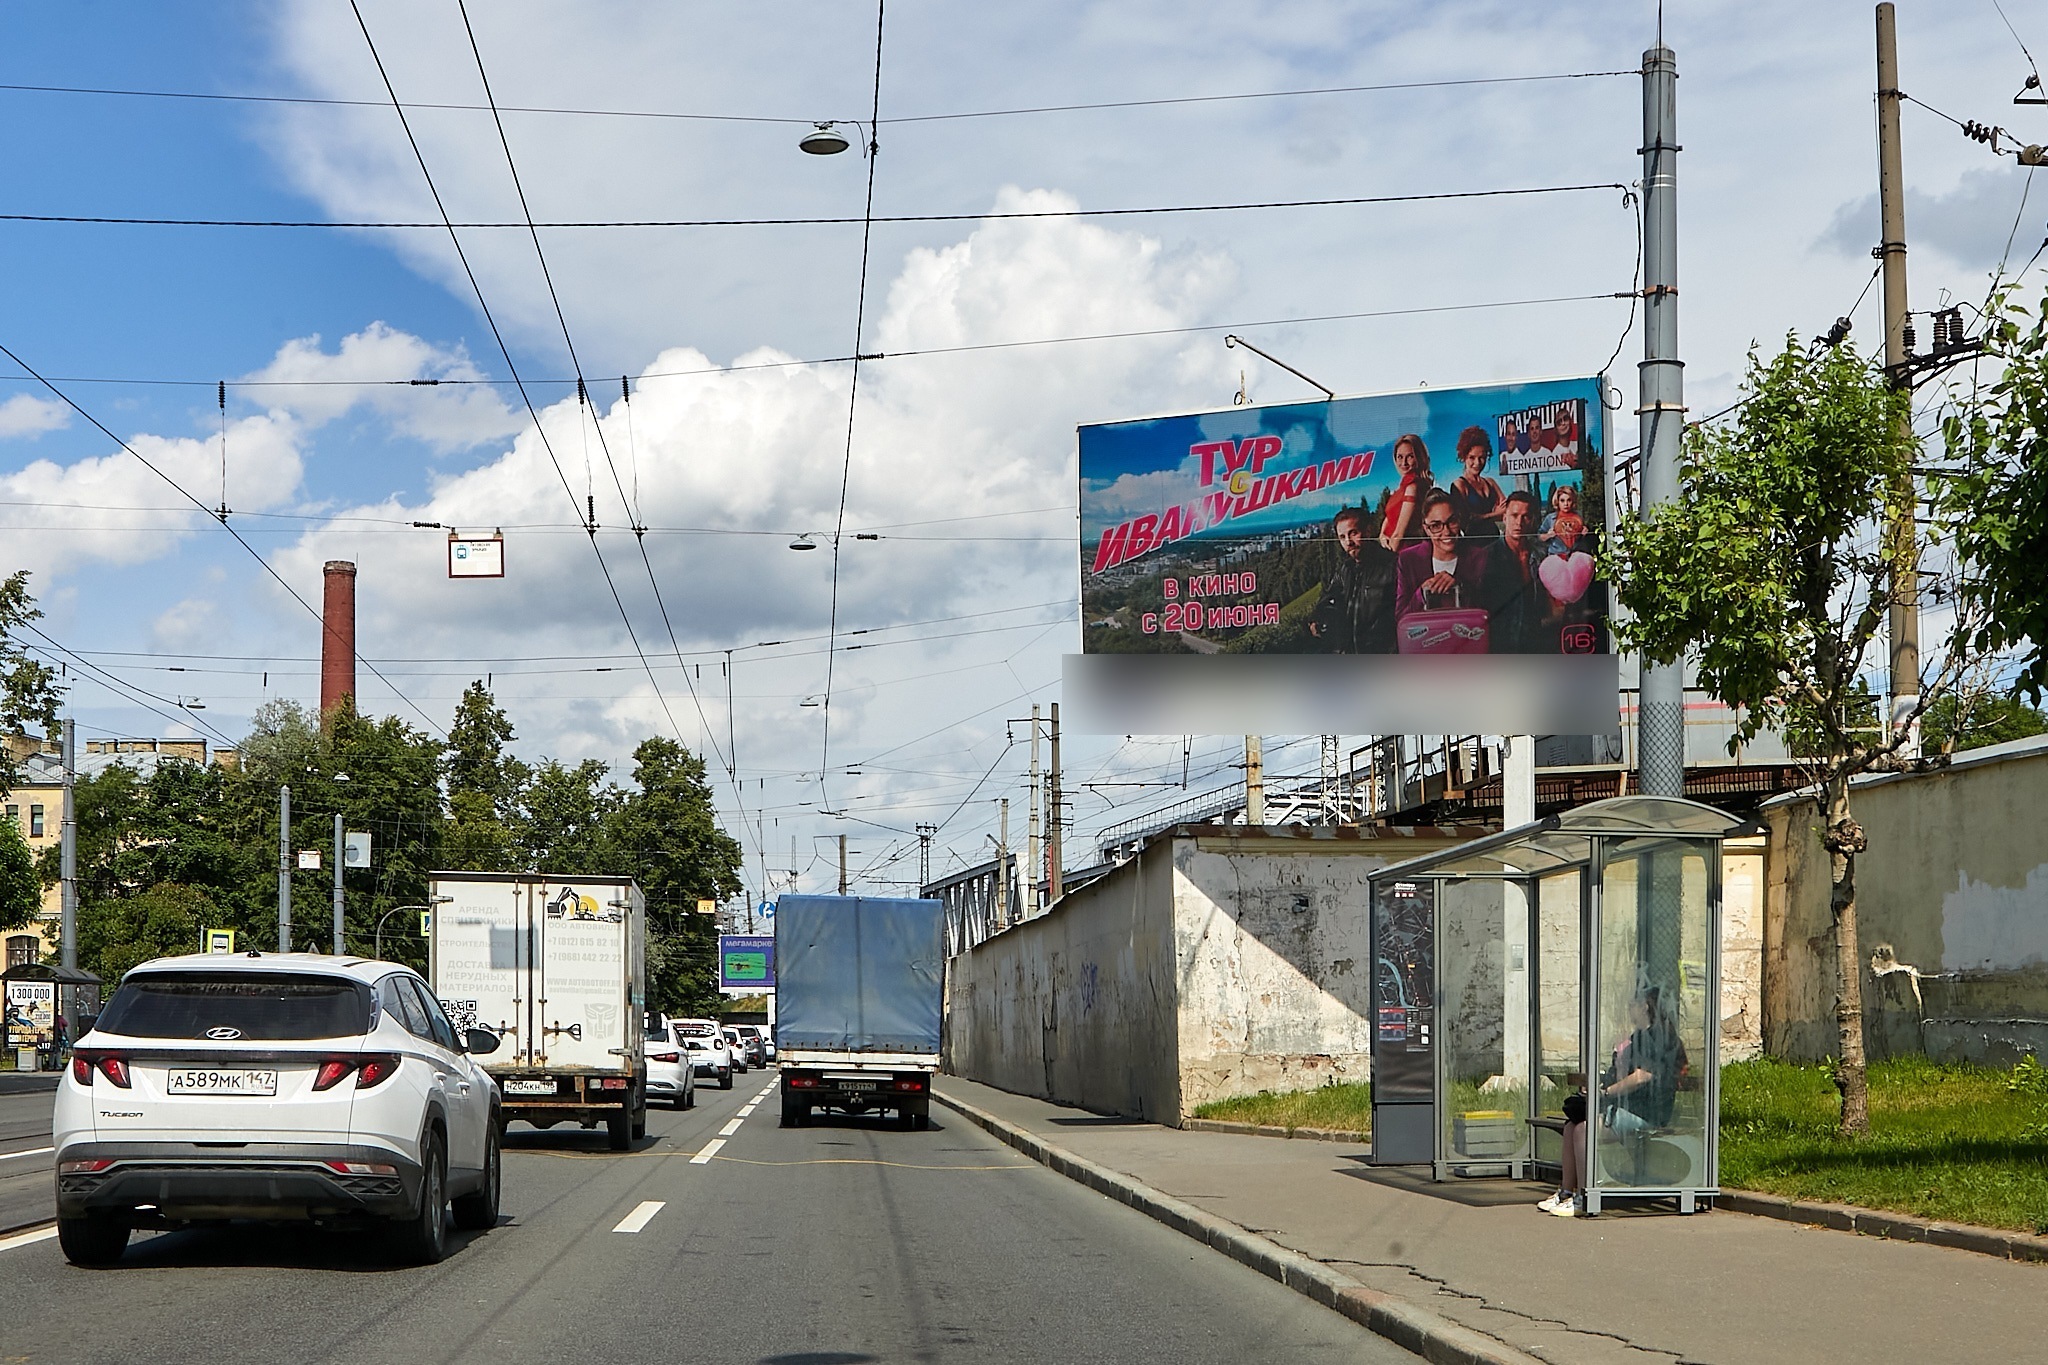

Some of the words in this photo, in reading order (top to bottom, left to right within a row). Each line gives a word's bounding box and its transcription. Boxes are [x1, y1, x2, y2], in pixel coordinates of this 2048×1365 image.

[1190, 435, 1283, 487] ТУР
[1508, 455, 1568, 471] TERNATION
[1091, 451, 1376, 577] ИВАНУШКАМИ
[1164, 578, 1179, 600] В
[1188, 572, 1257, 599] КИНО
[1163, 601, 1203, 633] 20
[458, 906, 500, 915] АРЕНДА
[440, 916, 515, 926] СПЕЦТЕХНИКИ
[547, 936, 557, 945] +7
[580, 938, 594, 946] 615
[596, 938, 607, 947] 82
[548, 952, 557, 961] +7
[582, 953, 597, 962] 442
[599, 954, 610, 962] 22
[612, 954, 622, 963] 22
[447, 960, 507, 970] ДОСТАВКА
[446, 972, 508, 981] НЕРУДНЫХ
[439, 983, 515, 992] МАТЕРИАЛОВ
[16, 988, 32, 999] 300
[34, 989, 50, 999] 000
[174, 1072, 241, 1088] А589МК
[246, 1072, 272, 1084] 147
[506, 1081, 540, 1091] Н204КН
